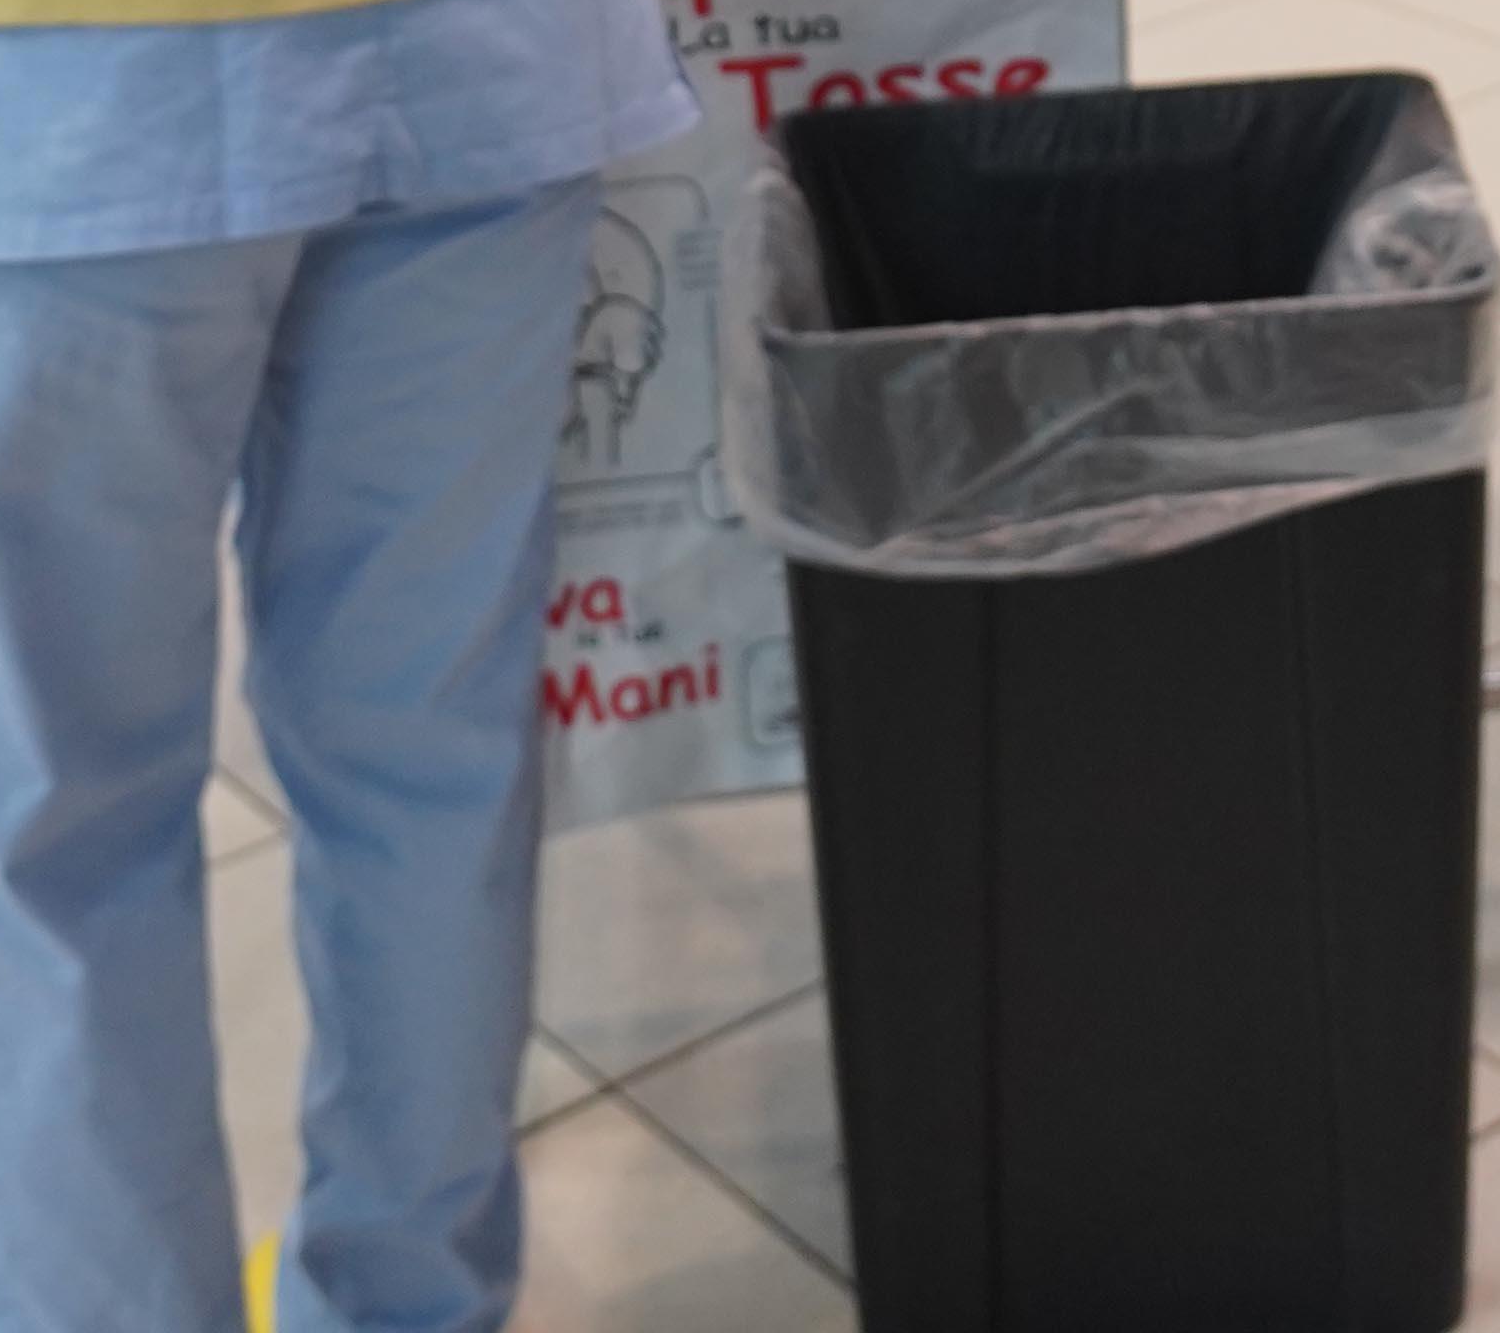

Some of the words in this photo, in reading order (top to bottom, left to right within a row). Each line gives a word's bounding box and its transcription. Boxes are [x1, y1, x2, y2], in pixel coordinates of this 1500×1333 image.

[753, 13, 841, 46] tua
[718, 53, 1051, 133] Tosse
[540, 641, 722, 727] Mani
